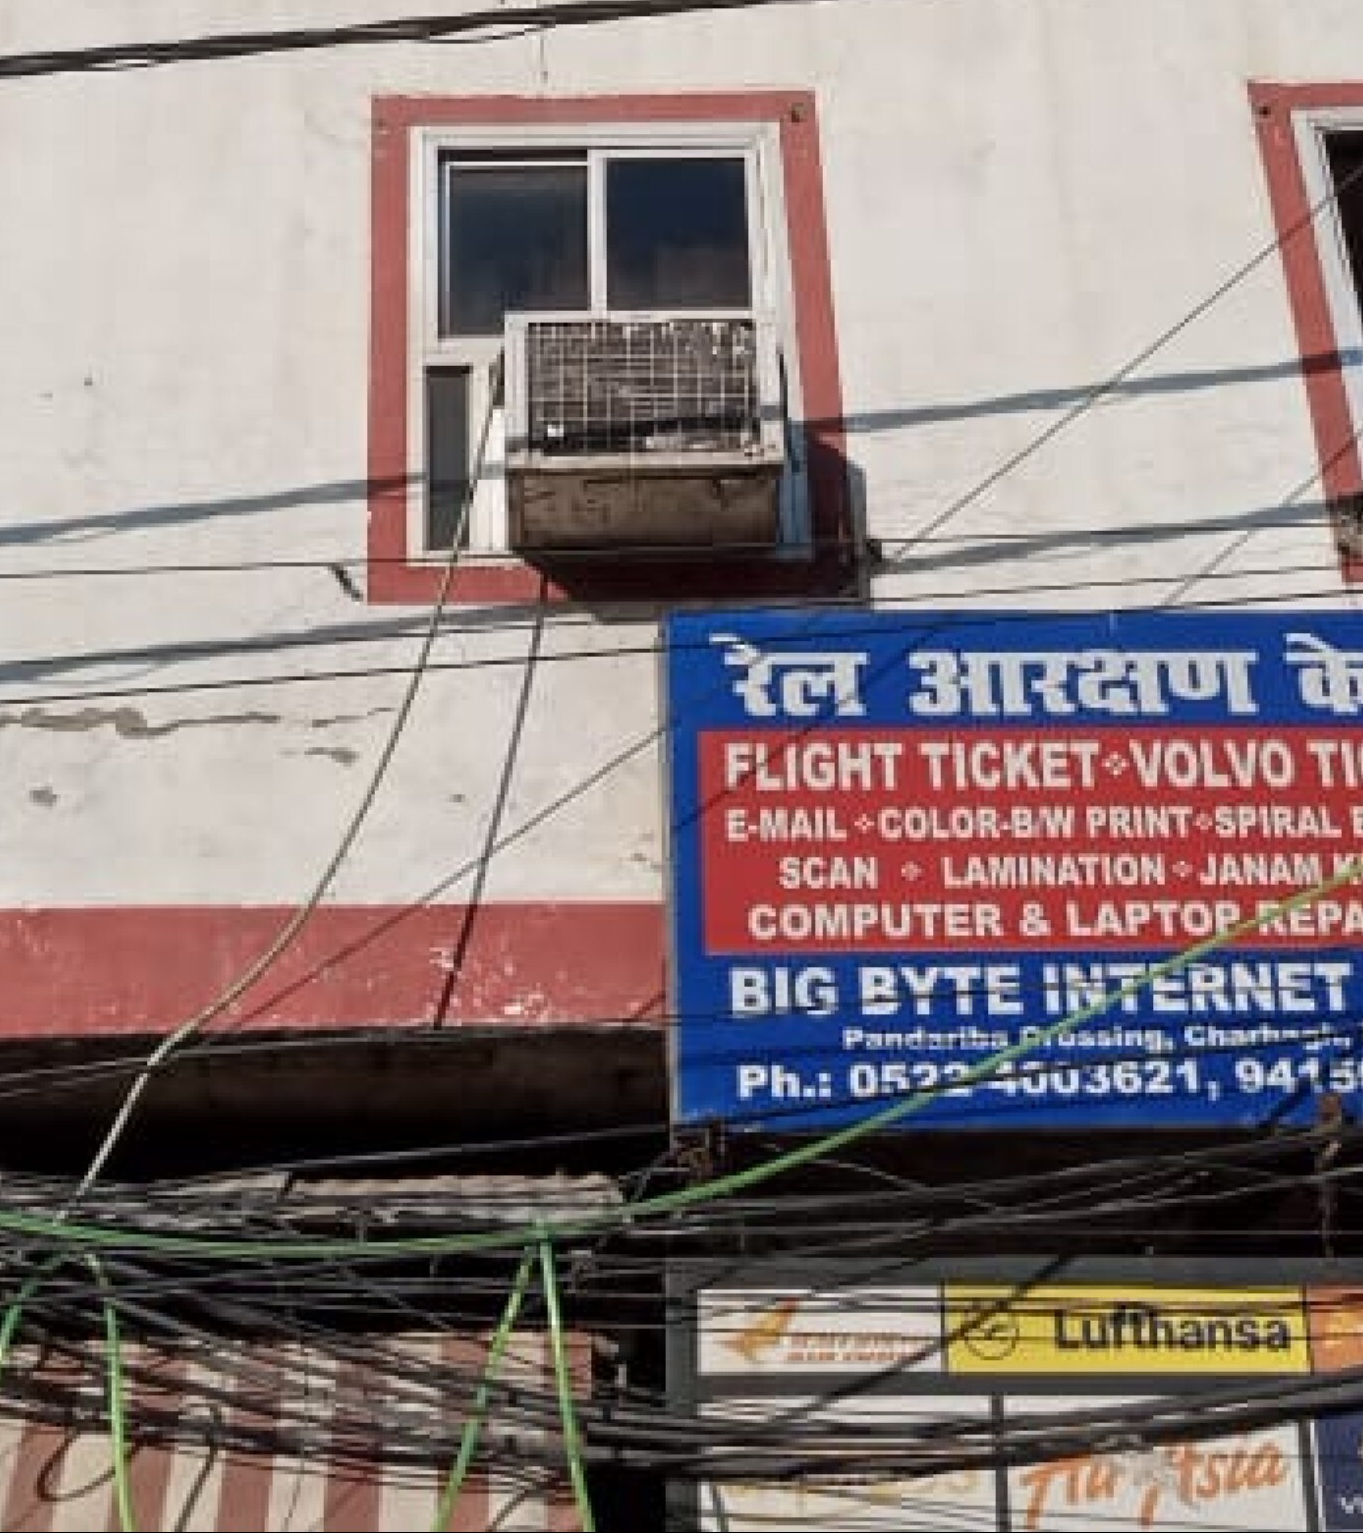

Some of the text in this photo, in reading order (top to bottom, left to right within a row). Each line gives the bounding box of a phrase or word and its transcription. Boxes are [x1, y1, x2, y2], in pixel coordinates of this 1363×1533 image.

[709, 633, 869, 717] रेल
[909, 648, 1260, 717] आरक्षण
[723, 741, 903, 792] FLIGHT
[918, 741, 1100, 791] TICKET
[1129, 739, 1295, 788] VOLVO
[724, 807, 848, 843] E-MAIL
[1085, 805, 1194, 839] PRINT
[1214, 805, 1343, 839] SPIRAL
[778, 856, 880, 890] SCAN
[942, 853, 1166, 889] LAMINATION
[1199, 852, 1321, 886] JANAM
[747, 902, 1005, 941] COMPUTER
[1018, 901, 1052, 937] &
[1066, 900, 1241, 938] LAPTOP
[730, 964, 837, 1017] BIG
[860, 963, 1024, 1015] BYTE
[1043, 961, 1354, 1014] INTERNET
[842, 1026, 1010, 1050] Pandariba
[737, 1064, 833, 1099] Ph.:
[1054, 1305, 1291, 1352] Lufthansa
